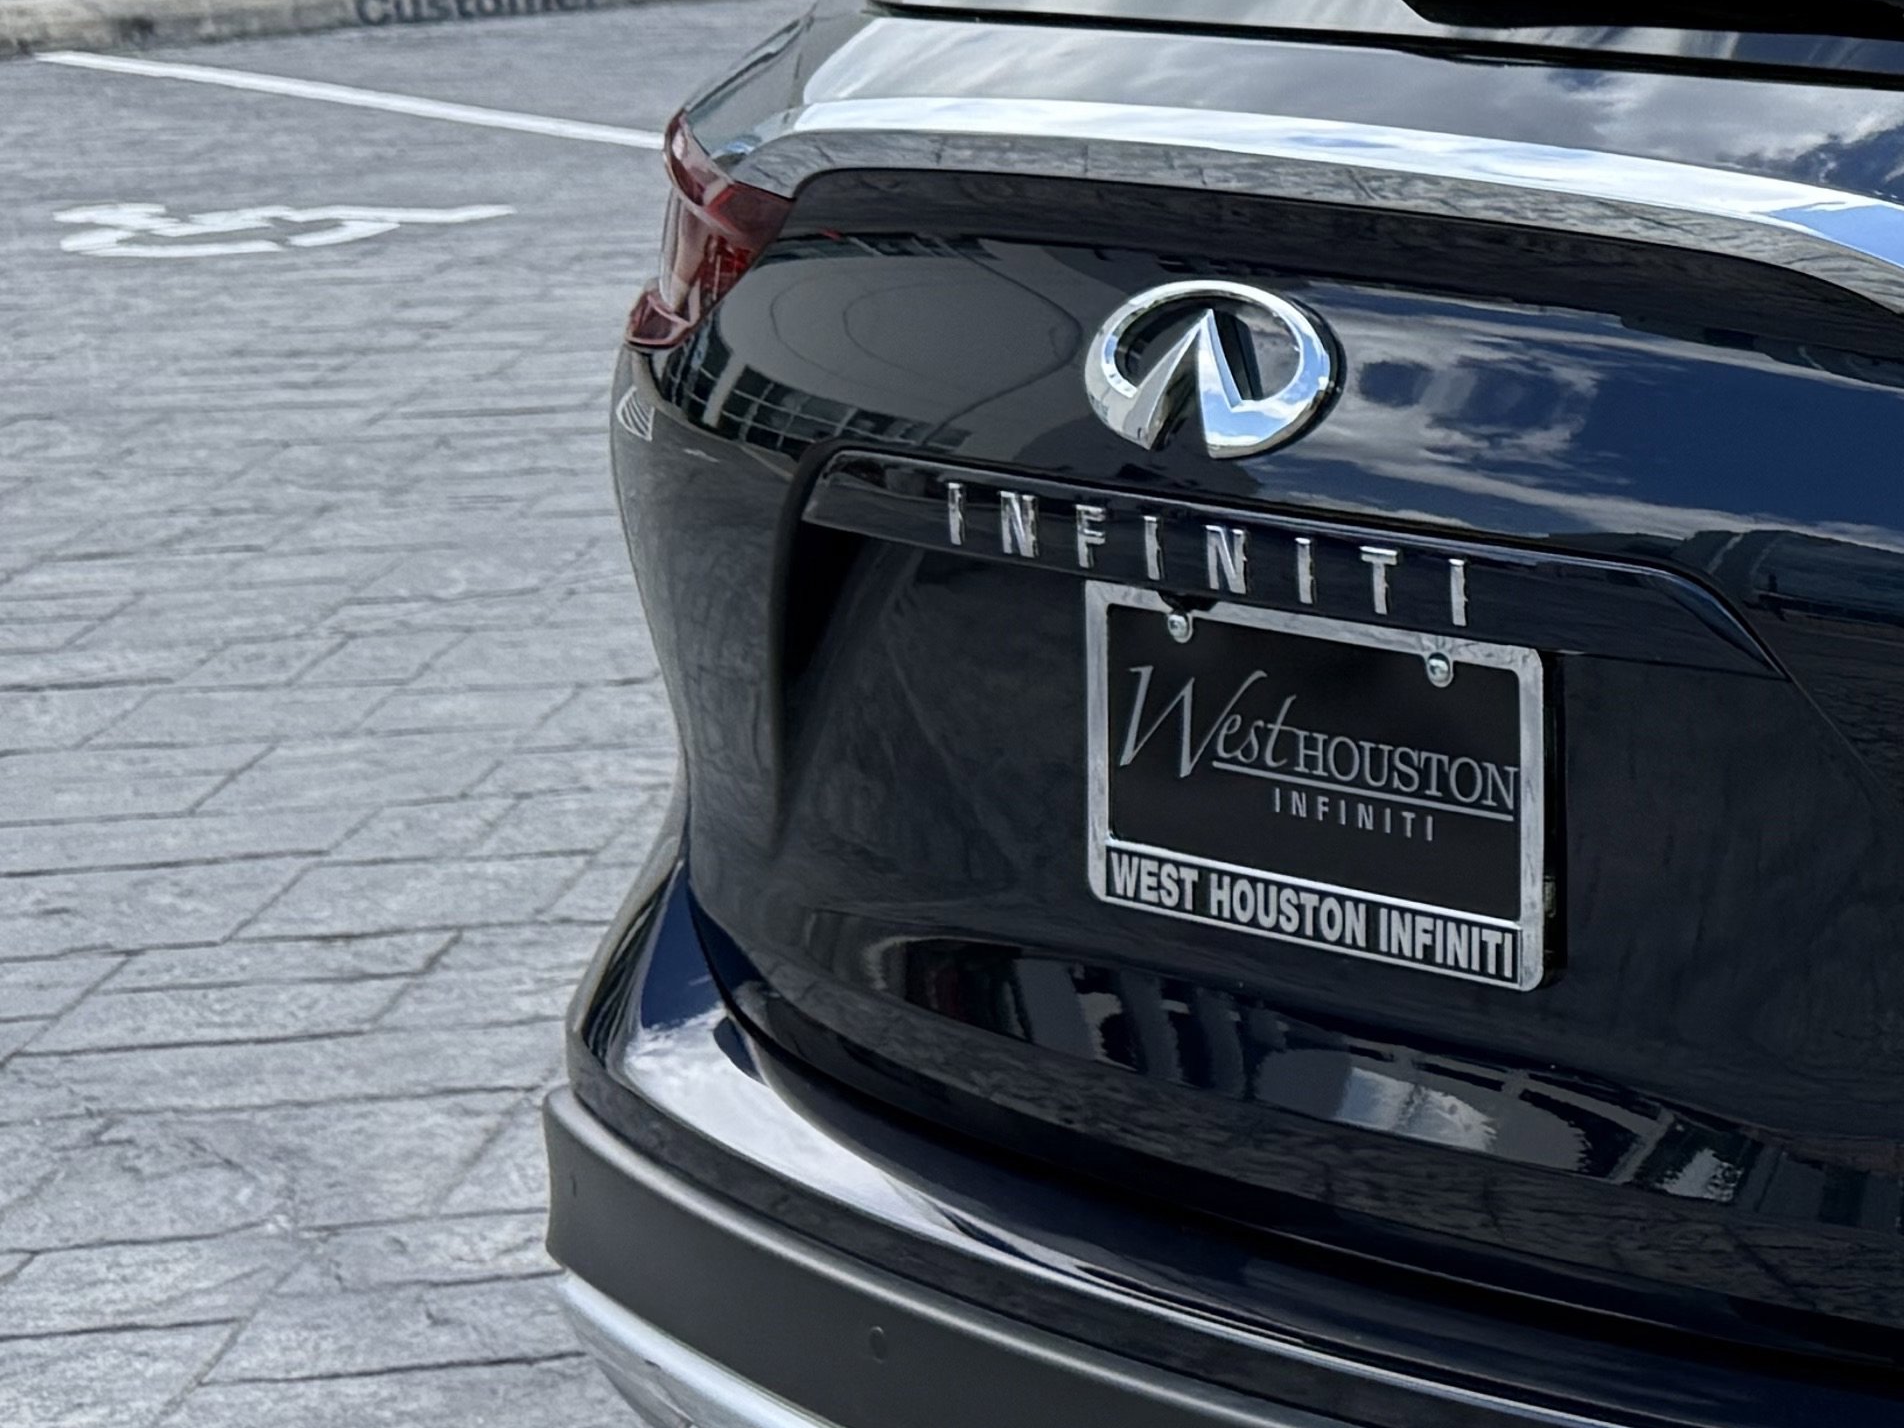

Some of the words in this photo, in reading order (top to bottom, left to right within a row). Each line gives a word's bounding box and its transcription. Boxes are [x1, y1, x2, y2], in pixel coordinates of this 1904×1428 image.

[947, 482, 1468, 627] INFINITI
[1118, 663, 1298, 779] West
[1295, 728, 1520, 812] HOUSTON
[1272, 786, 1436, 842] INFINITI
[1110, 851, 1200, 909] WEST
[1208, 880, 1367, 948] HOUSTON
[1378, 906, 1517, 979] INFINITI
